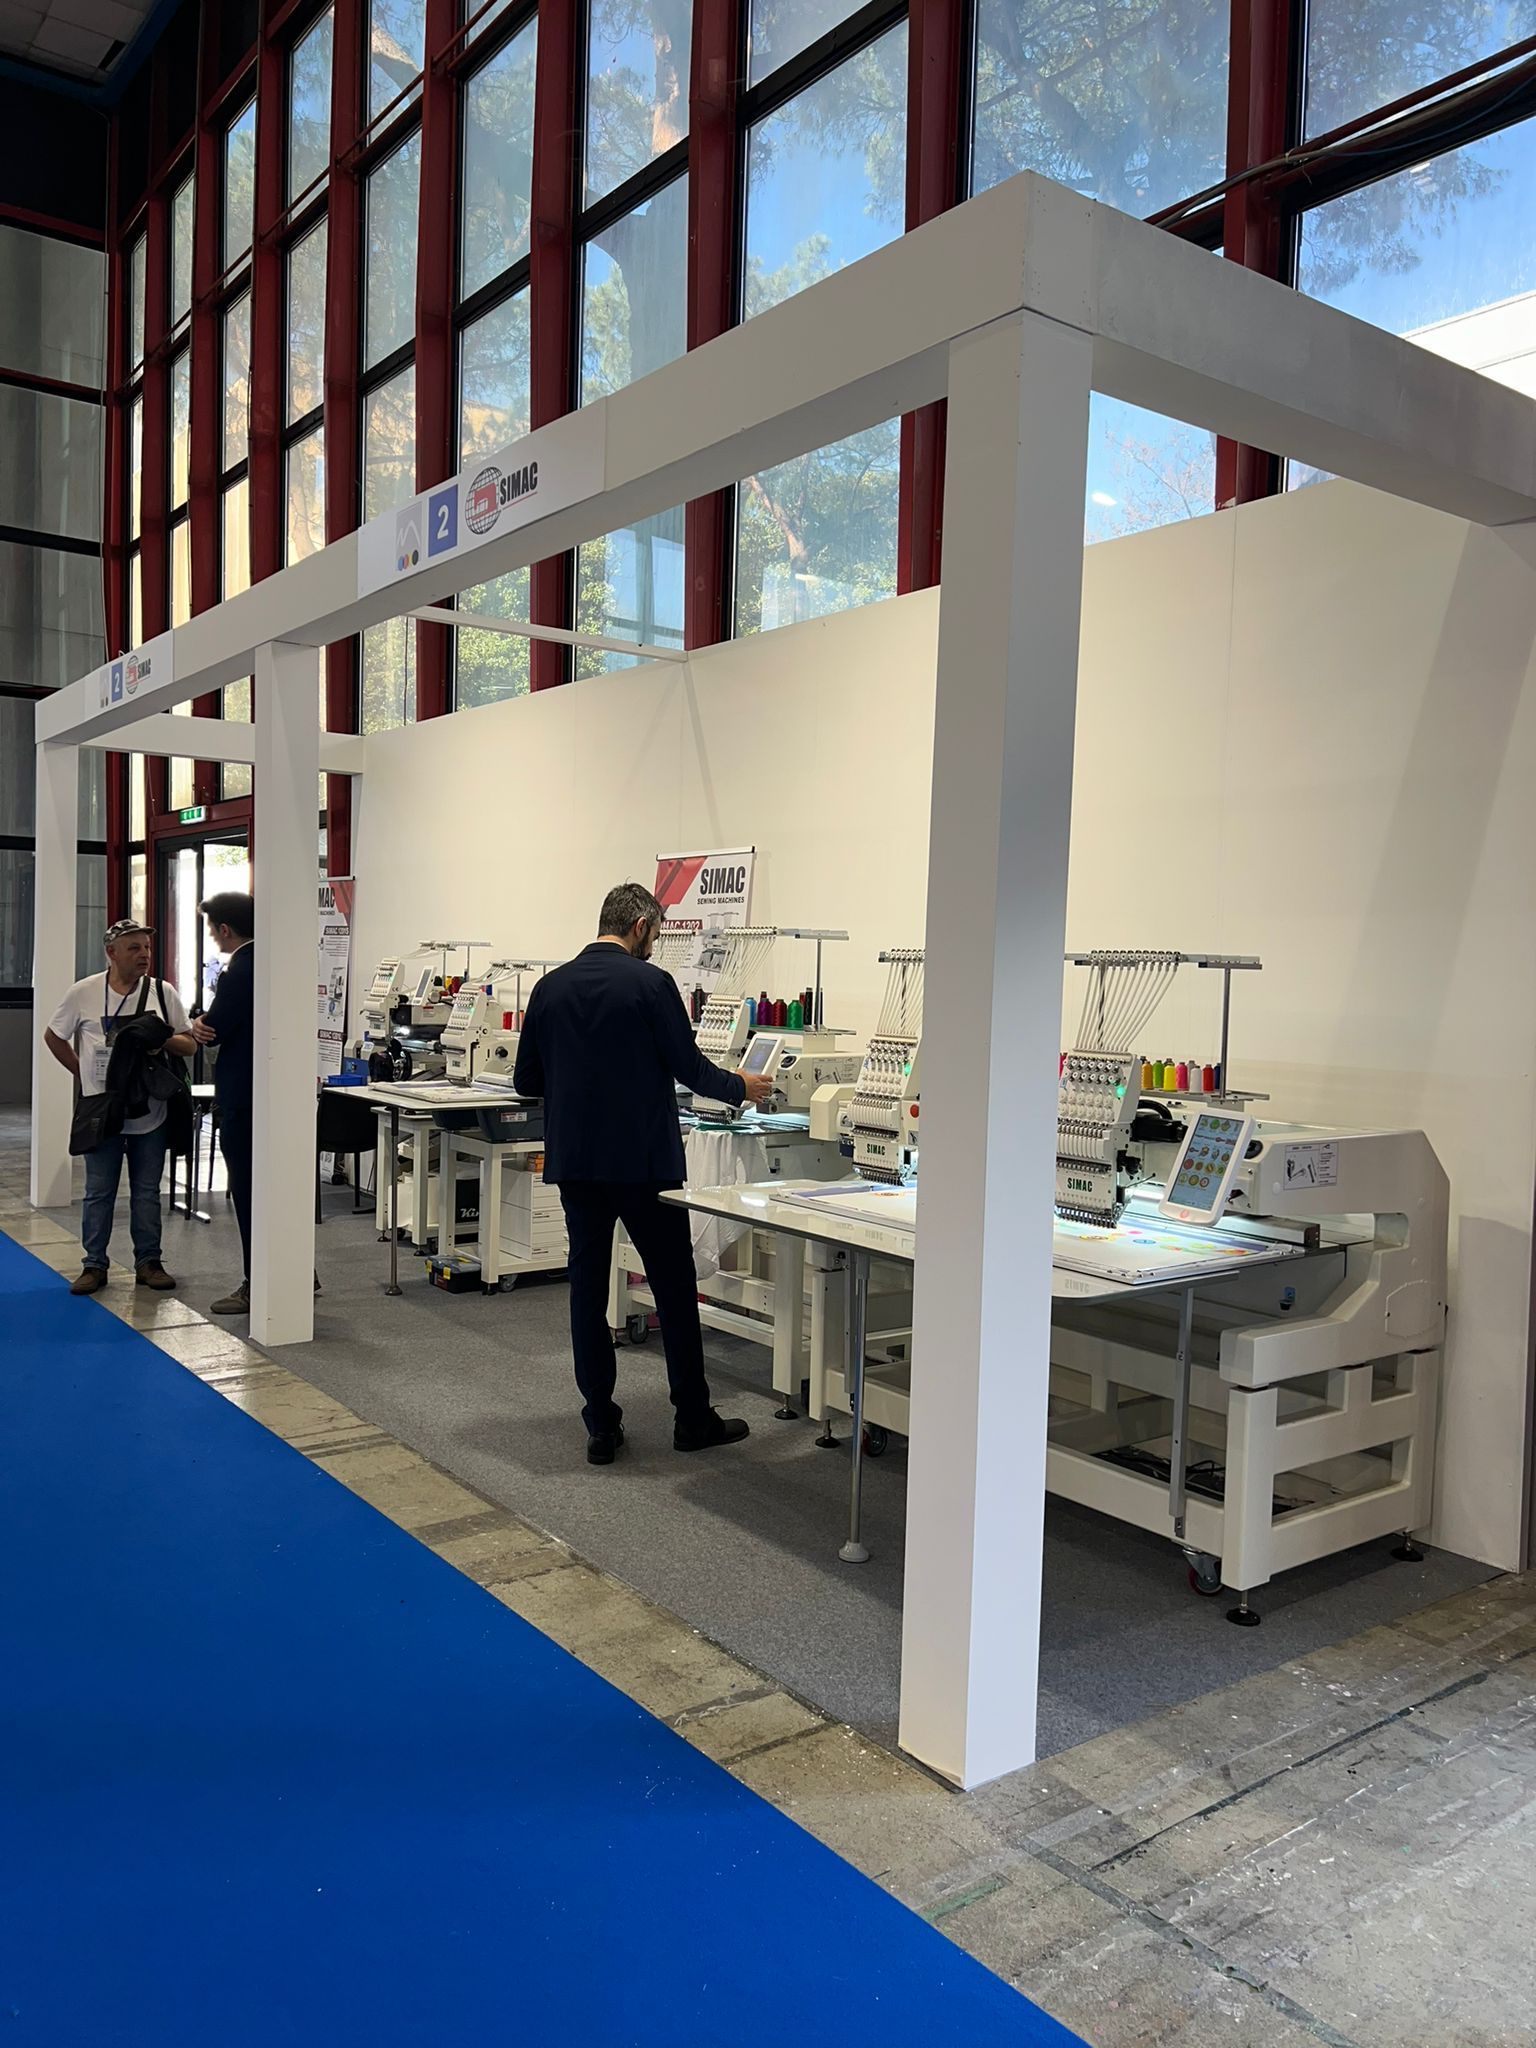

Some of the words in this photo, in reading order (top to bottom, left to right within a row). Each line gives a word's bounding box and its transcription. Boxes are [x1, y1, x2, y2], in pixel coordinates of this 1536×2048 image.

[437, 504, 449, 540] 2
[499, 461, 538, 505] SIMAC
[114, 672, 120, 693] 2
[700, 866, 746, 895] SIMAC
[318, 887, 336, 908] MAC
[697, 897, 717, 905] SEWING
[717, 896, 745, 904] MACHINES
[866, 1143, 886, 1156] SIMAC
[1067, 1177, 1093, 1193] SIMAC
